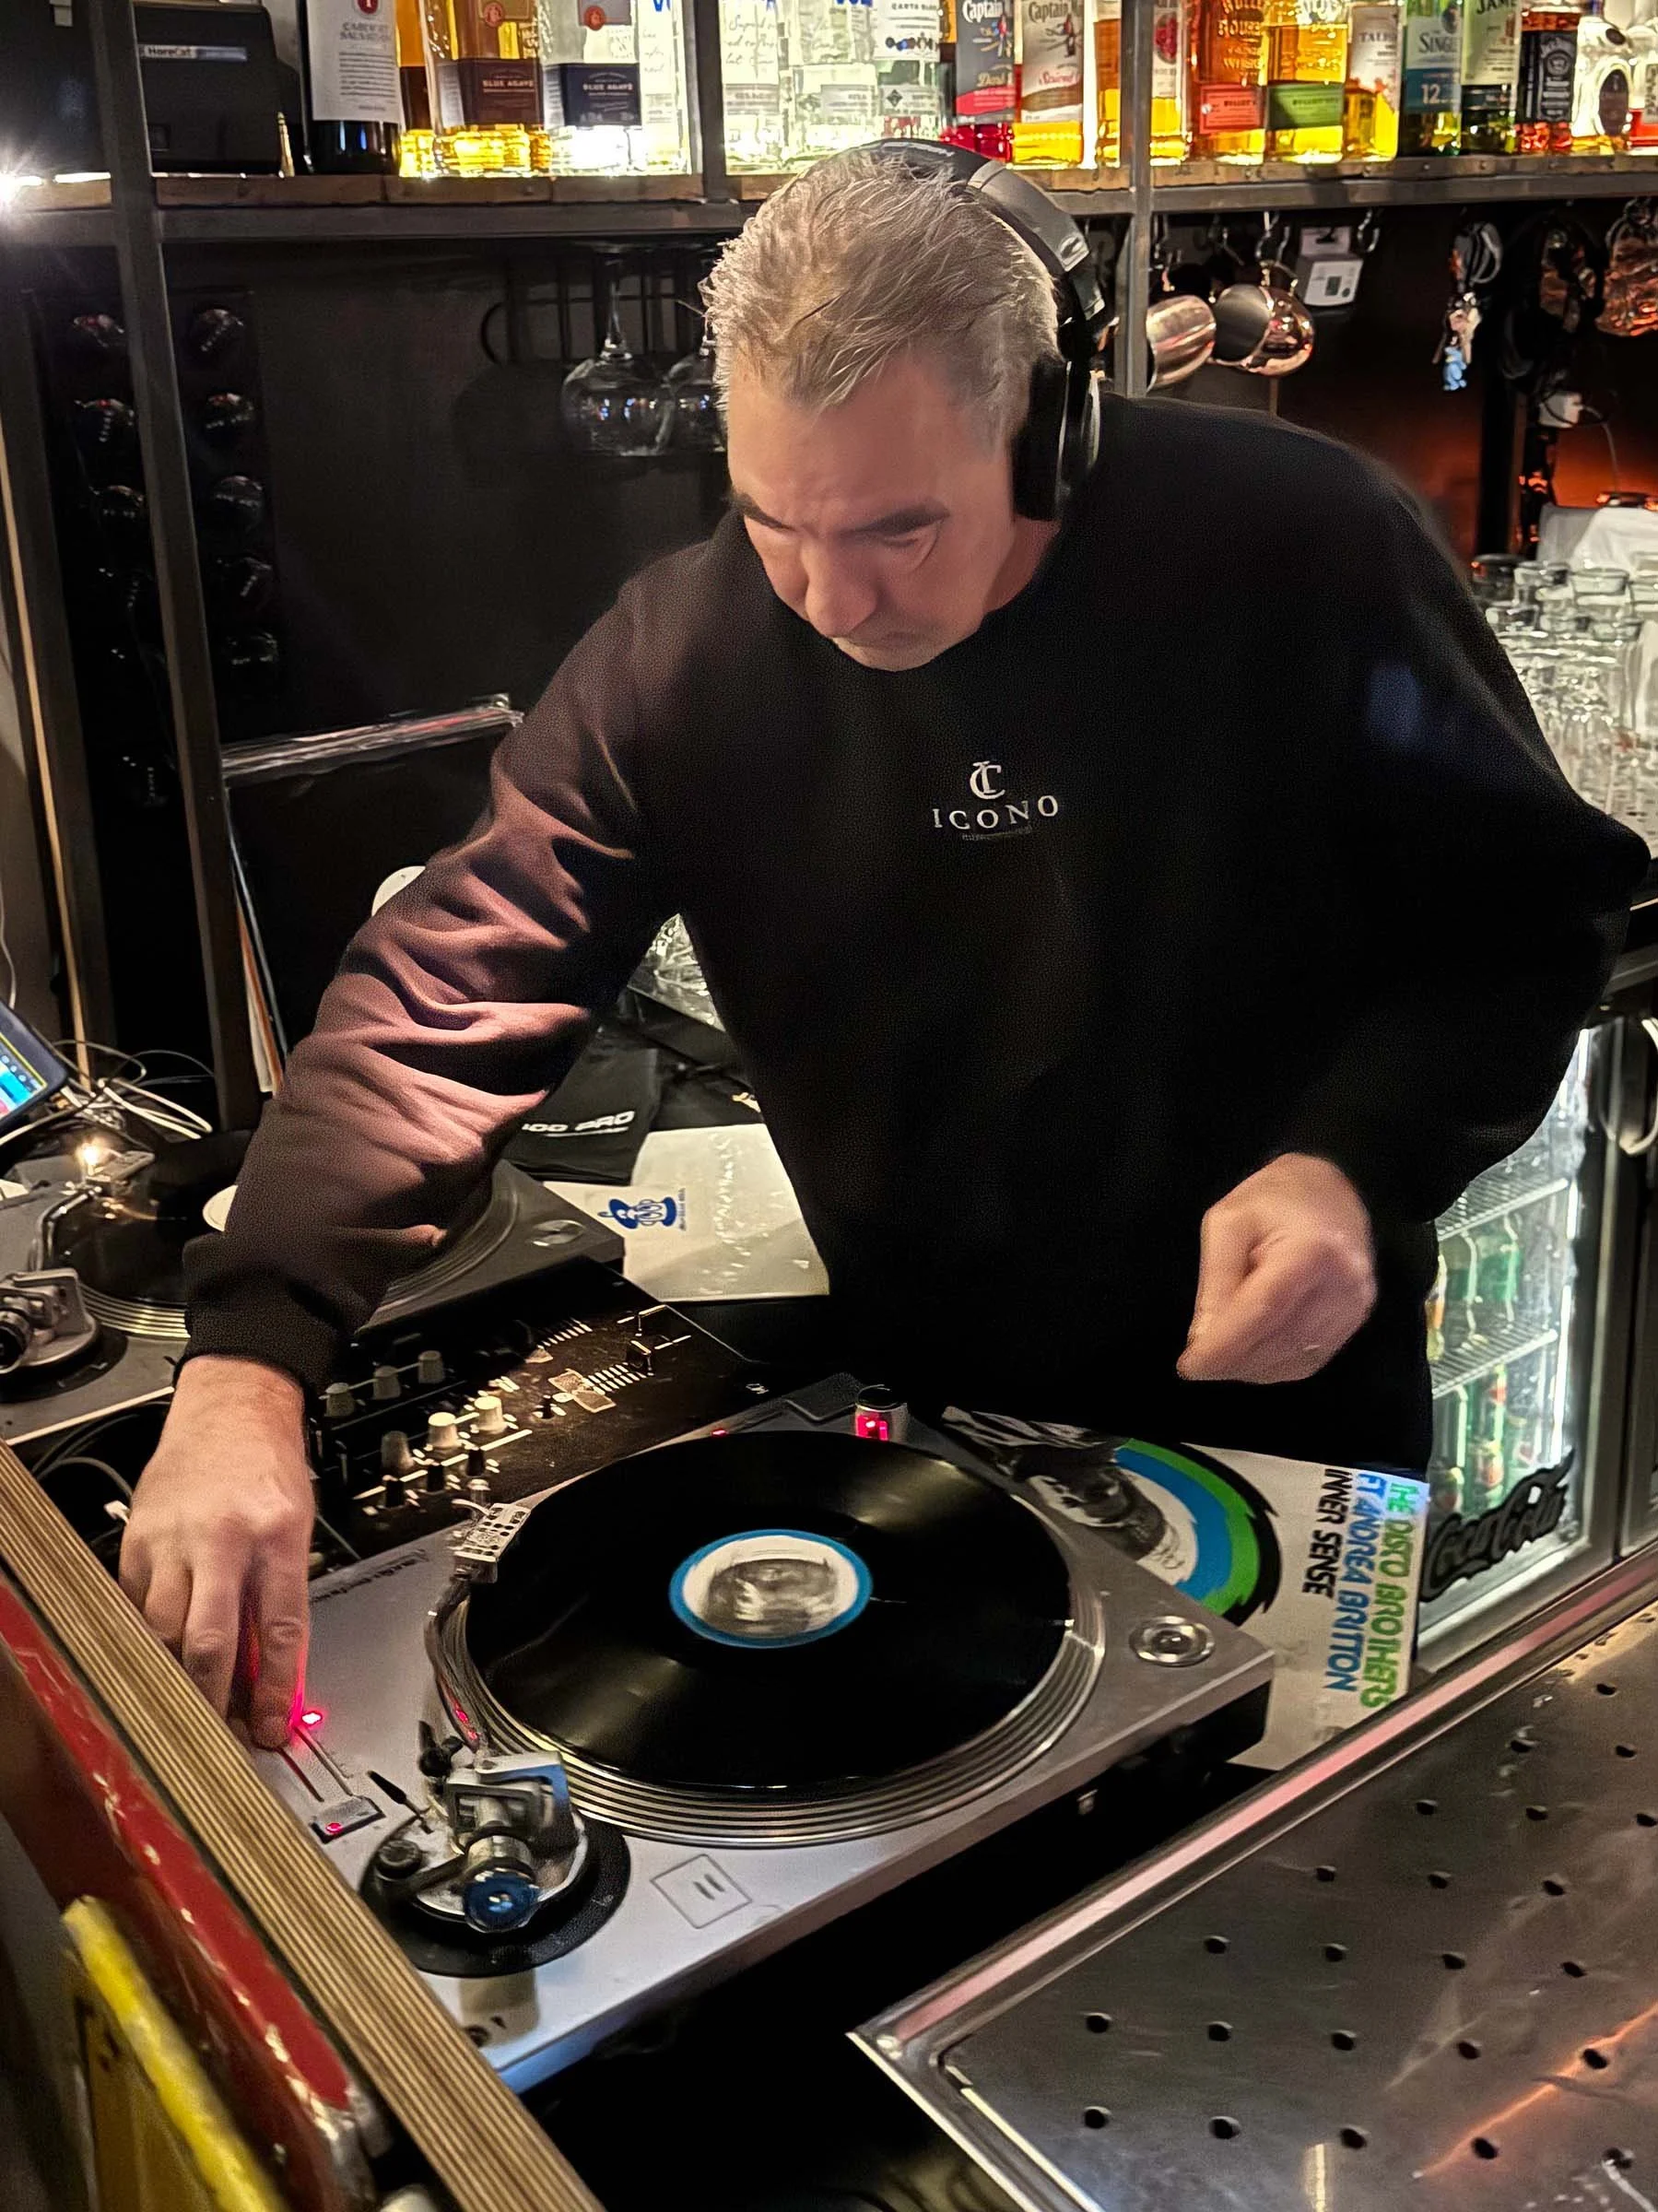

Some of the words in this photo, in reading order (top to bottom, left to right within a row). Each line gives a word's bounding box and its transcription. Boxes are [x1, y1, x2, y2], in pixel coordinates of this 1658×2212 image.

[932, 794, 1059, 830] ICONO
[574, 1111, 636, 1131] PRO
[1316, 1467, 1353, 1525] INNER
[1356, 1473, 1387, 1500] FT
[1387, 1482, 1420, 1516] THE
[1301, 1530, 1344, 1601] SENSE
[1339, 1496, 1386, 1585] ANDREA
[1379, 1519, 1415, 1578] DISCO
[1324, 1590, 1370, 1692] BRITTON
[1359, 1582, 1408, 1709] BROTHERS
